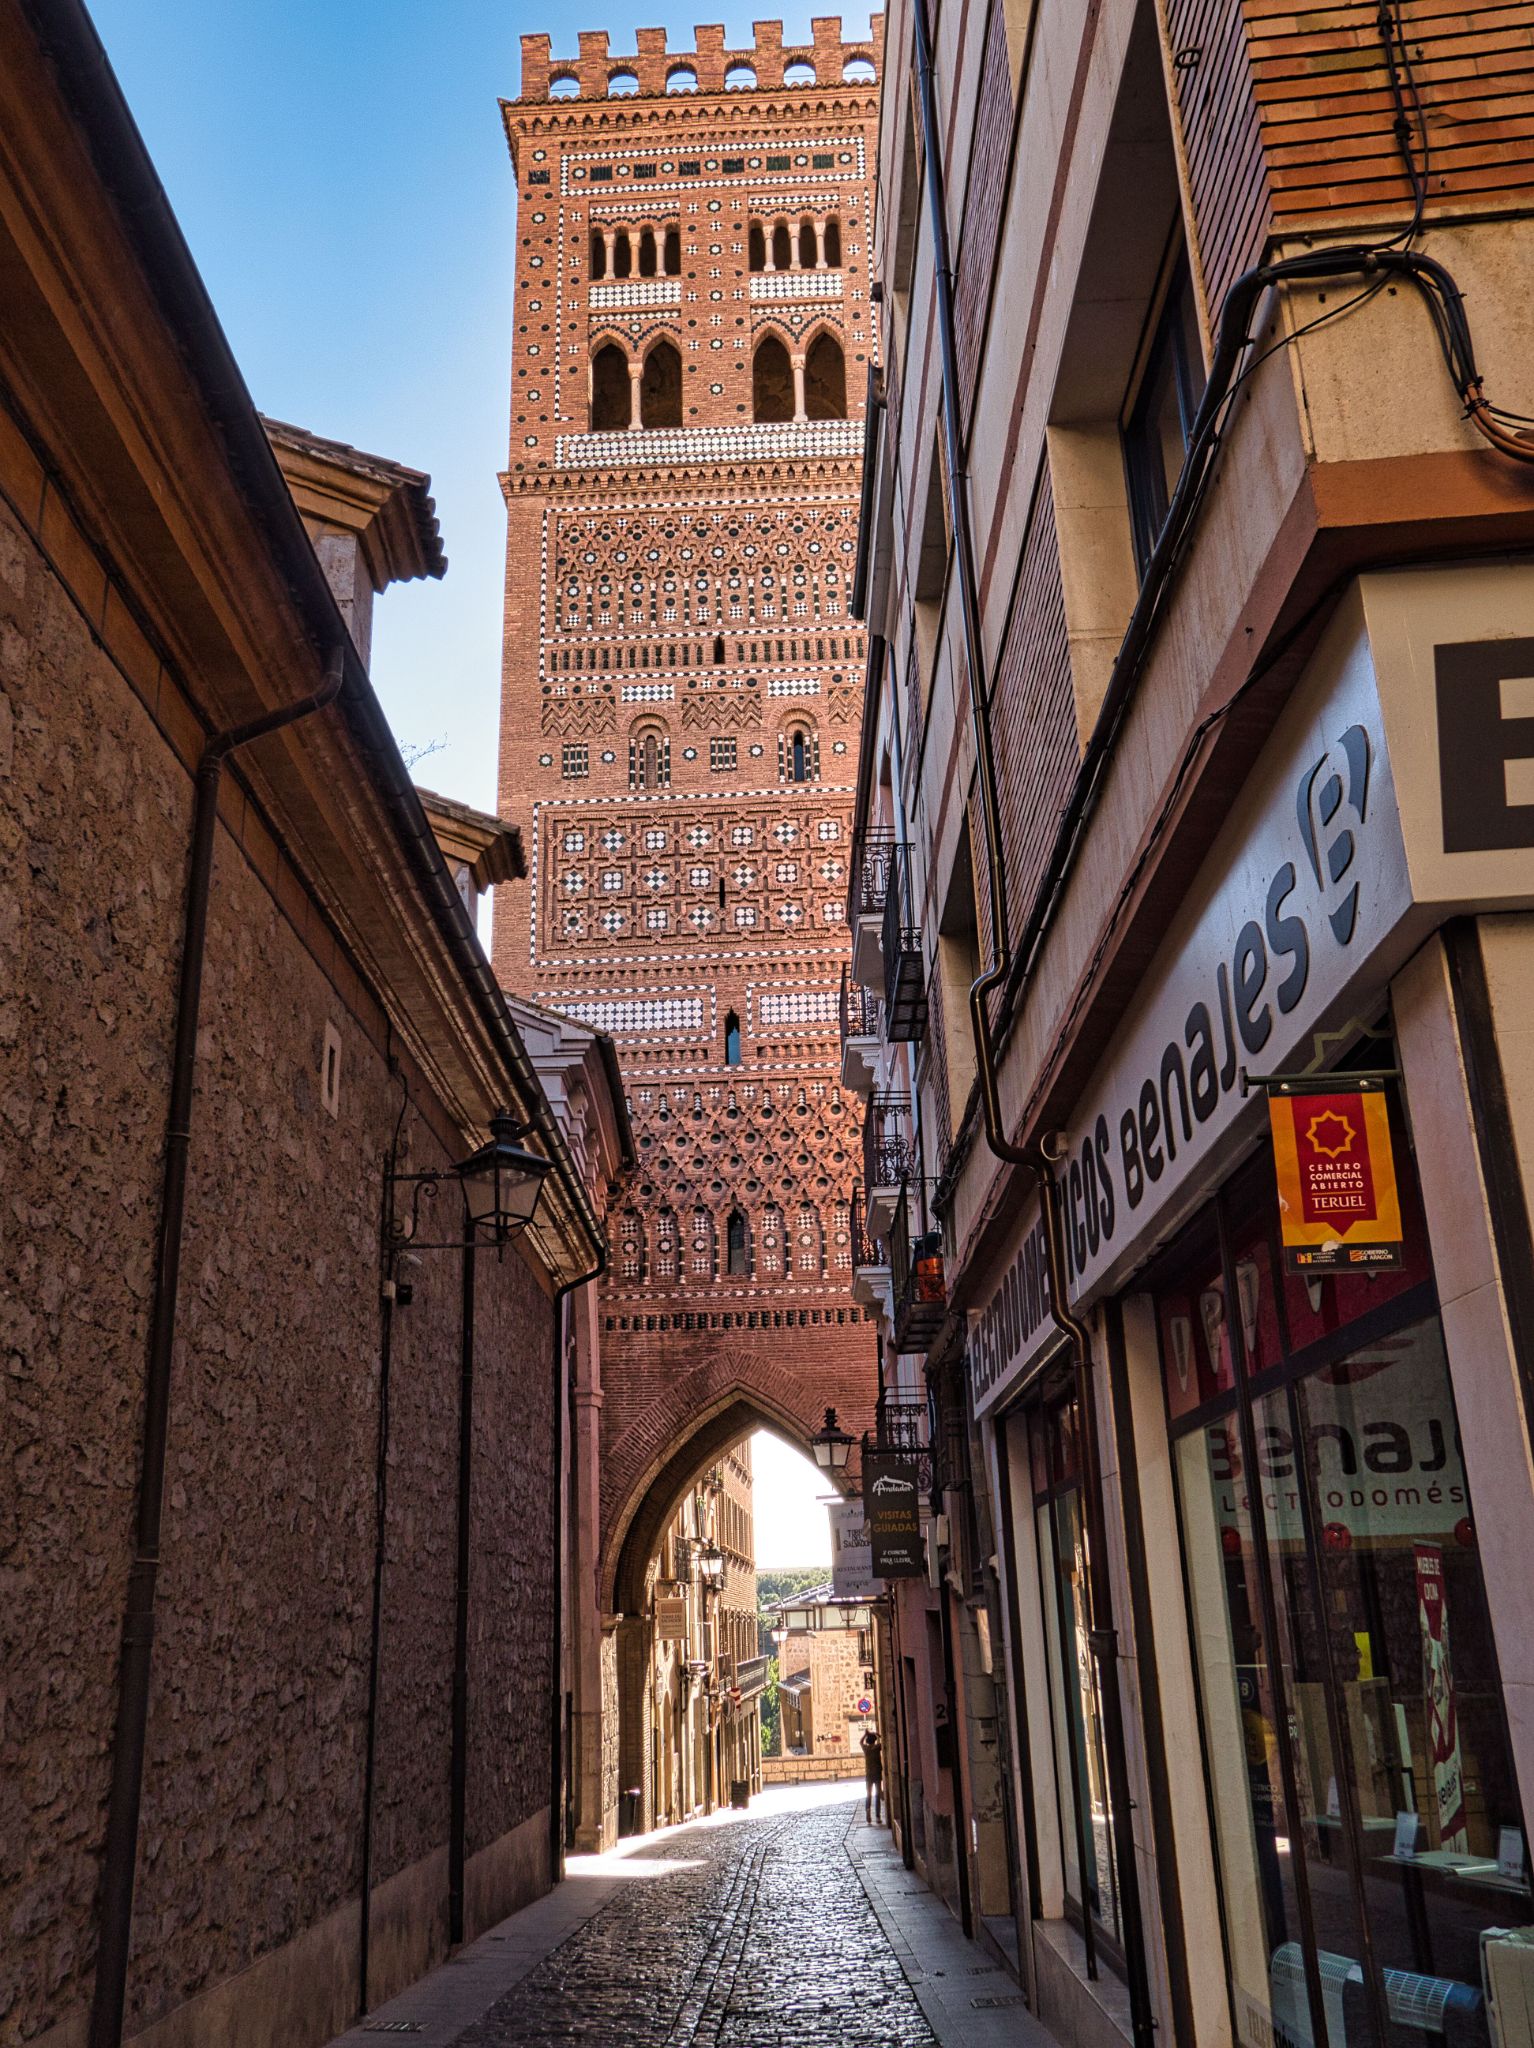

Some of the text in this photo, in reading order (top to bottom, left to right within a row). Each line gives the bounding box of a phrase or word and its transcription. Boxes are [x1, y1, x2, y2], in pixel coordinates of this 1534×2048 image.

[1309, 1162, 1361, 1172] CENTRO
[1310, 1171, 1362, 1181] COMERCIAL
[1311, 1180, 1364, 1190] ABIERTO
[1312, 1195, 1366, 1209] TERUEL
[877, 1510, 912, 1520] VISITAS
[873, 1522, 917, 1533] GUIADAS
[836, 1564, 872, 1573] RESTAURANT
